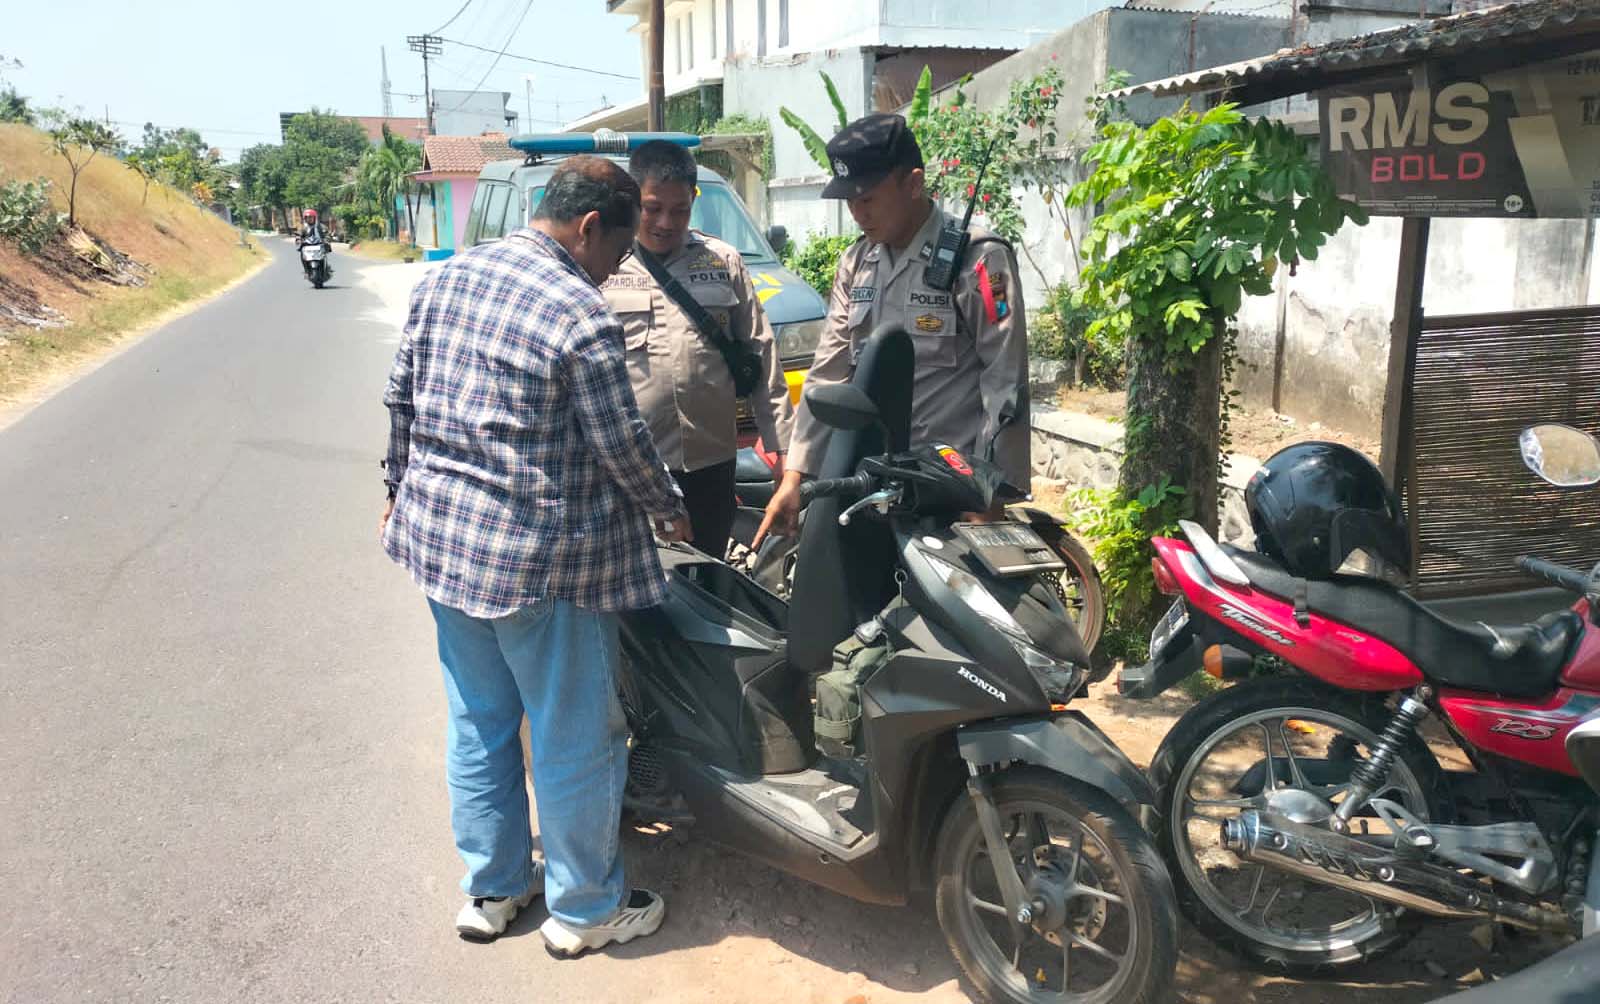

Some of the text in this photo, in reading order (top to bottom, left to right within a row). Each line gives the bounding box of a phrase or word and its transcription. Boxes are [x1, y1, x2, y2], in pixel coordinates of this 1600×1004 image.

[1328, 81, 1490, 151] RMS
[1370, 152, 1486, 183] BOLD
[689, 272, 731, 283] POLRI
[910, 293, 950, 305] POLISI
[956, 666, 1007, 703] HONDA
[1490, 718, 1557, 740] 125
